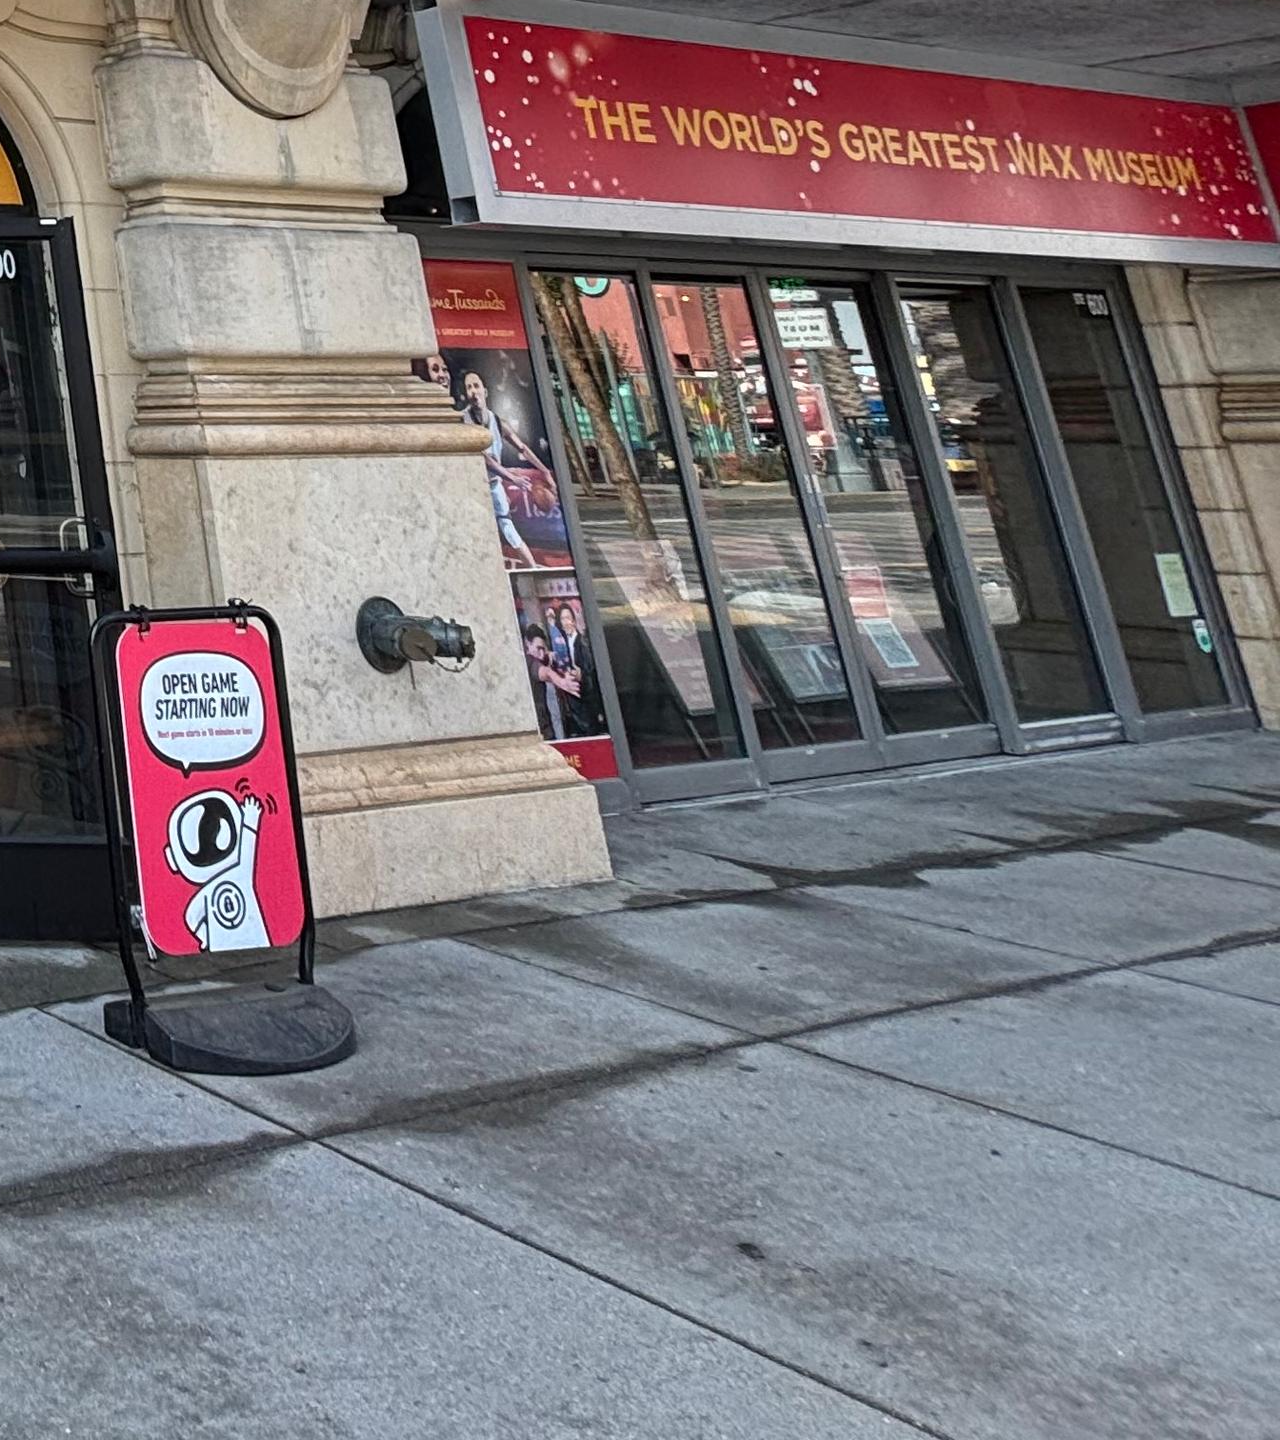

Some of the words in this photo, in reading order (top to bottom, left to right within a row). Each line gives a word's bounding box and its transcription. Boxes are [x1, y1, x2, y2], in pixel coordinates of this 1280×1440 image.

[573, 96, 657, 144] THE
[661, 106, 831, 159] WORLD'S
[839, 122, 1000, 174] GREATEST
[1005, 139, 1082, 181] WAX
[1082, 147, 1203, 191] MUSEUM
[162, 673, 197, 695] OPEN
[201, 672, 239, 693] GAME
[155, 697, 216, 720] STARTING
[220, 696, 250, 718] NOW
